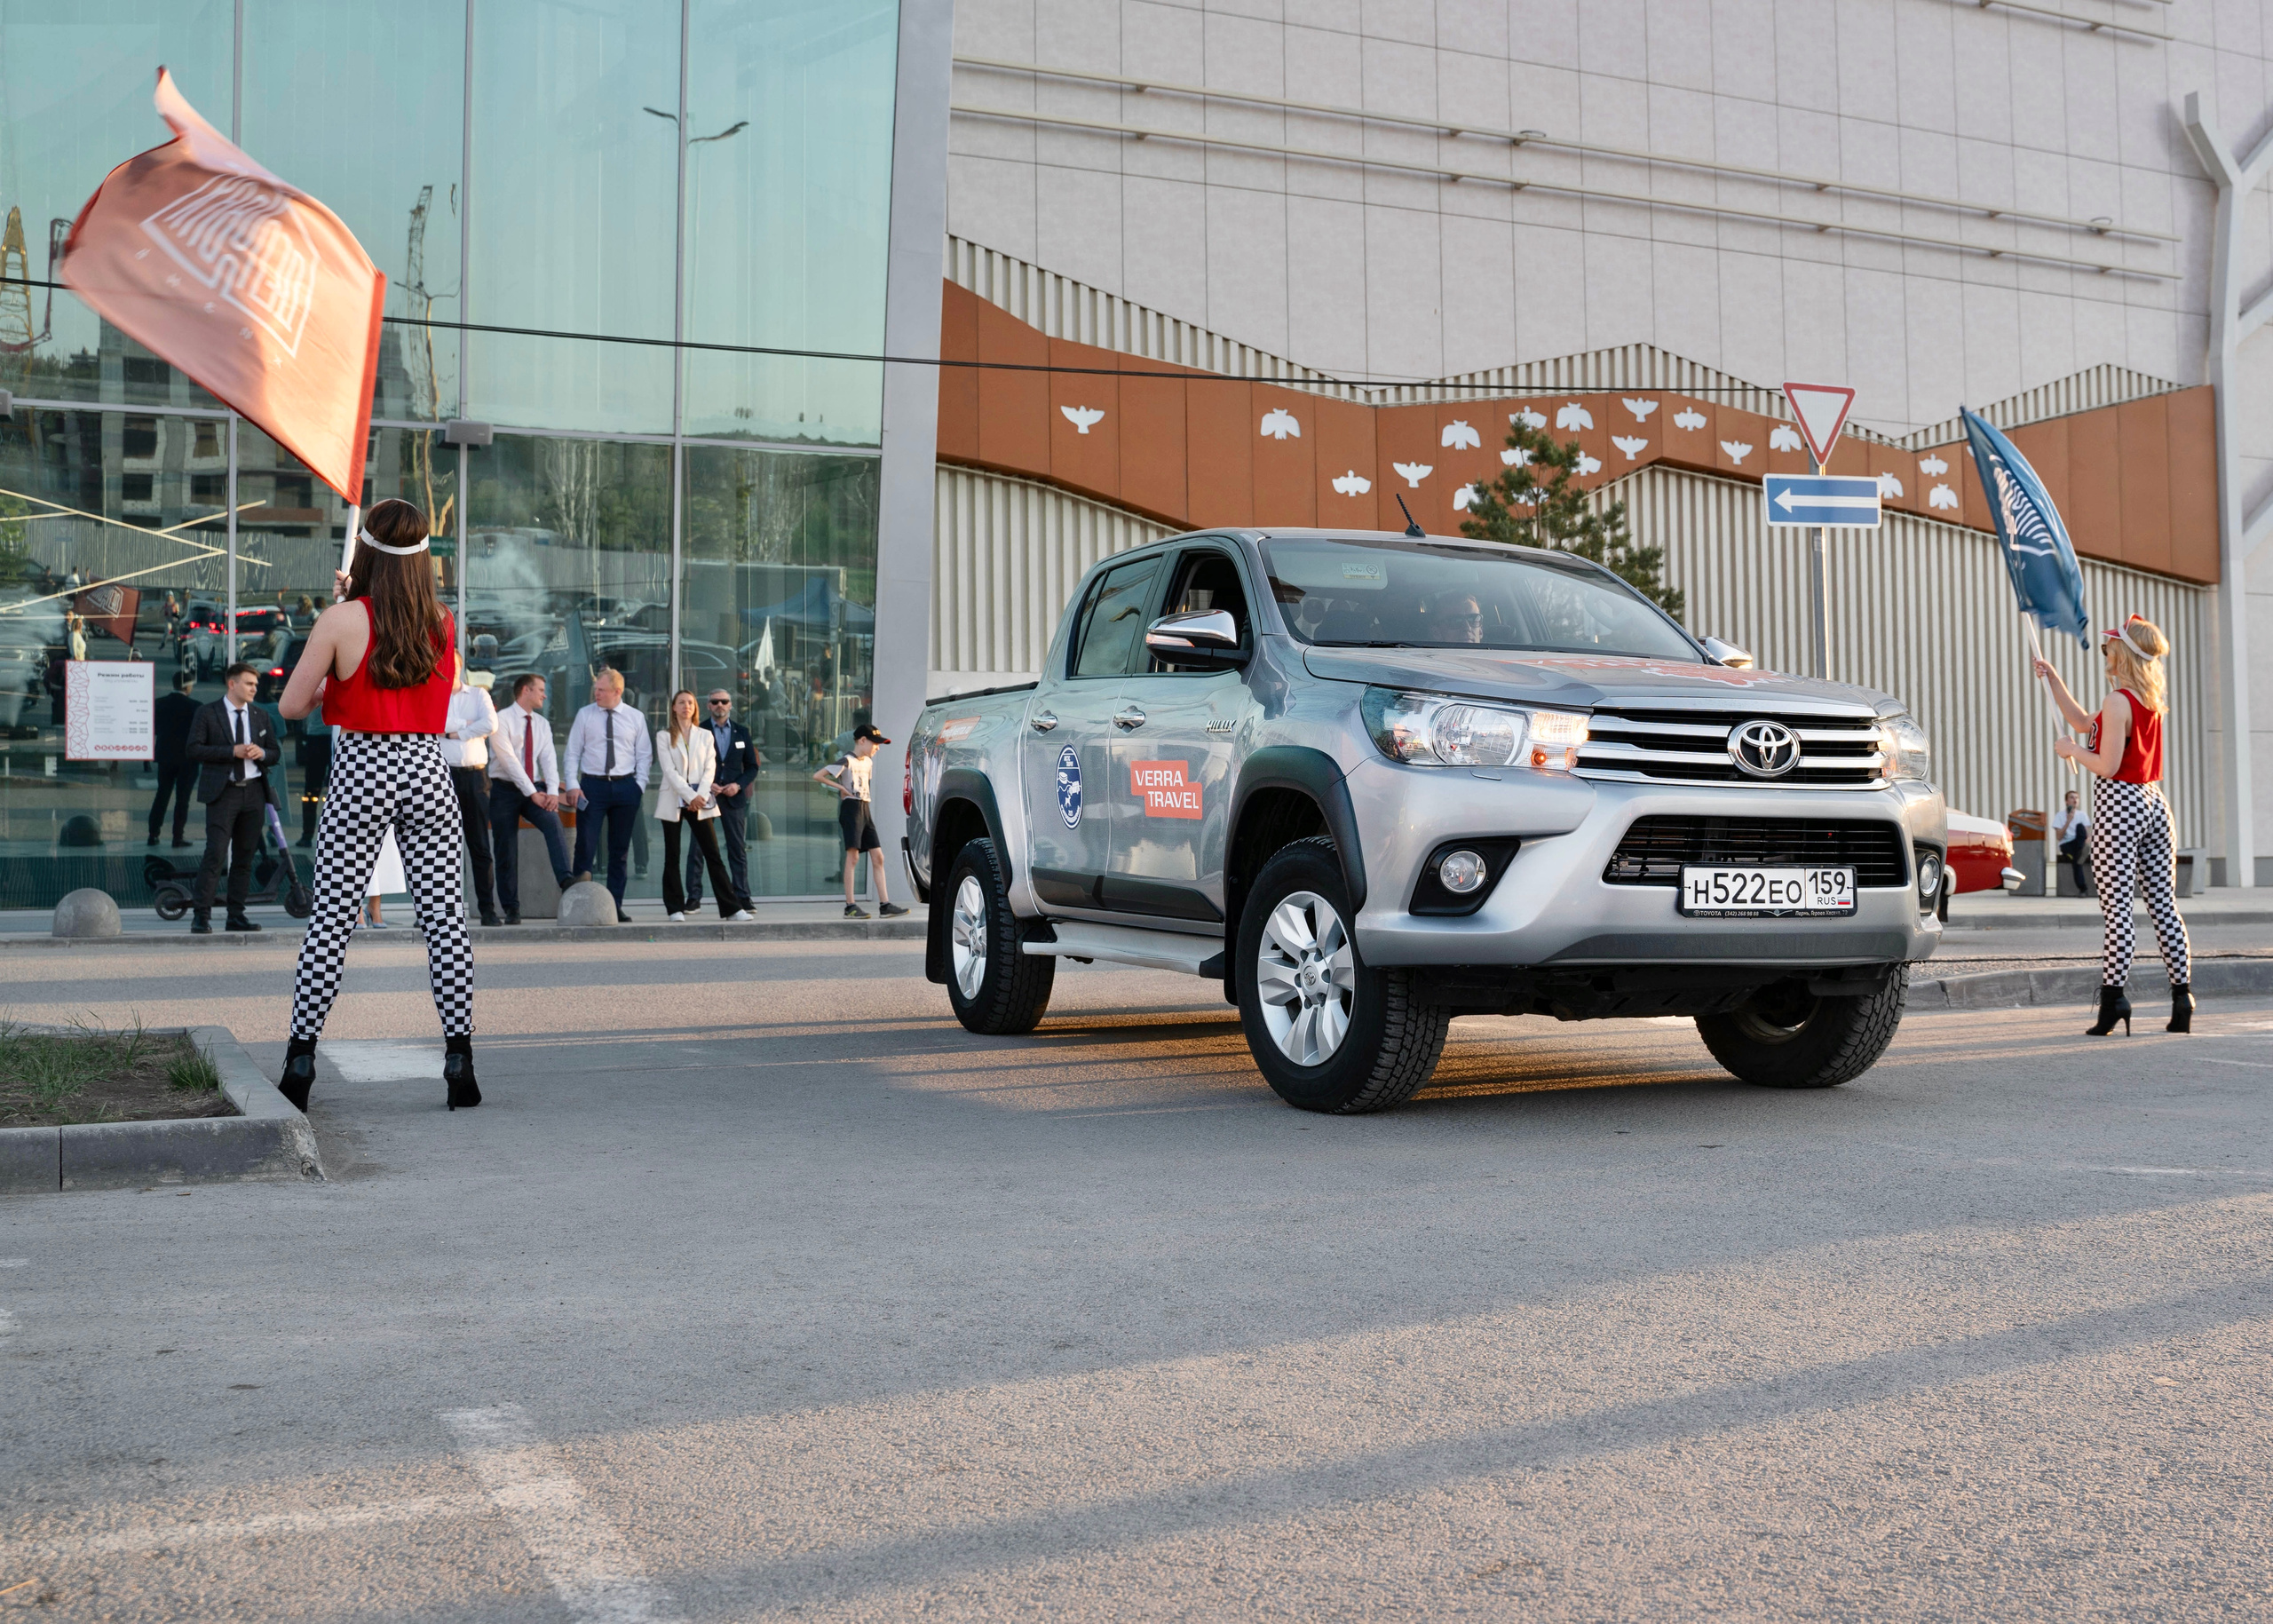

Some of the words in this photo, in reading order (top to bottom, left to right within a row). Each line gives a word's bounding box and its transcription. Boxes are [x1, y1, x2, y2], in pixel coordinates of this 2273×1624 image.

[1205, 719, 1237, 733] HILUX
[1135, 770, 1184, 787] VERRA
[1147, 790, 1200, 809] TRAVEL
[1809, 871, 1846, 895] 159
[1817, 896, 1836, 905] RUS
